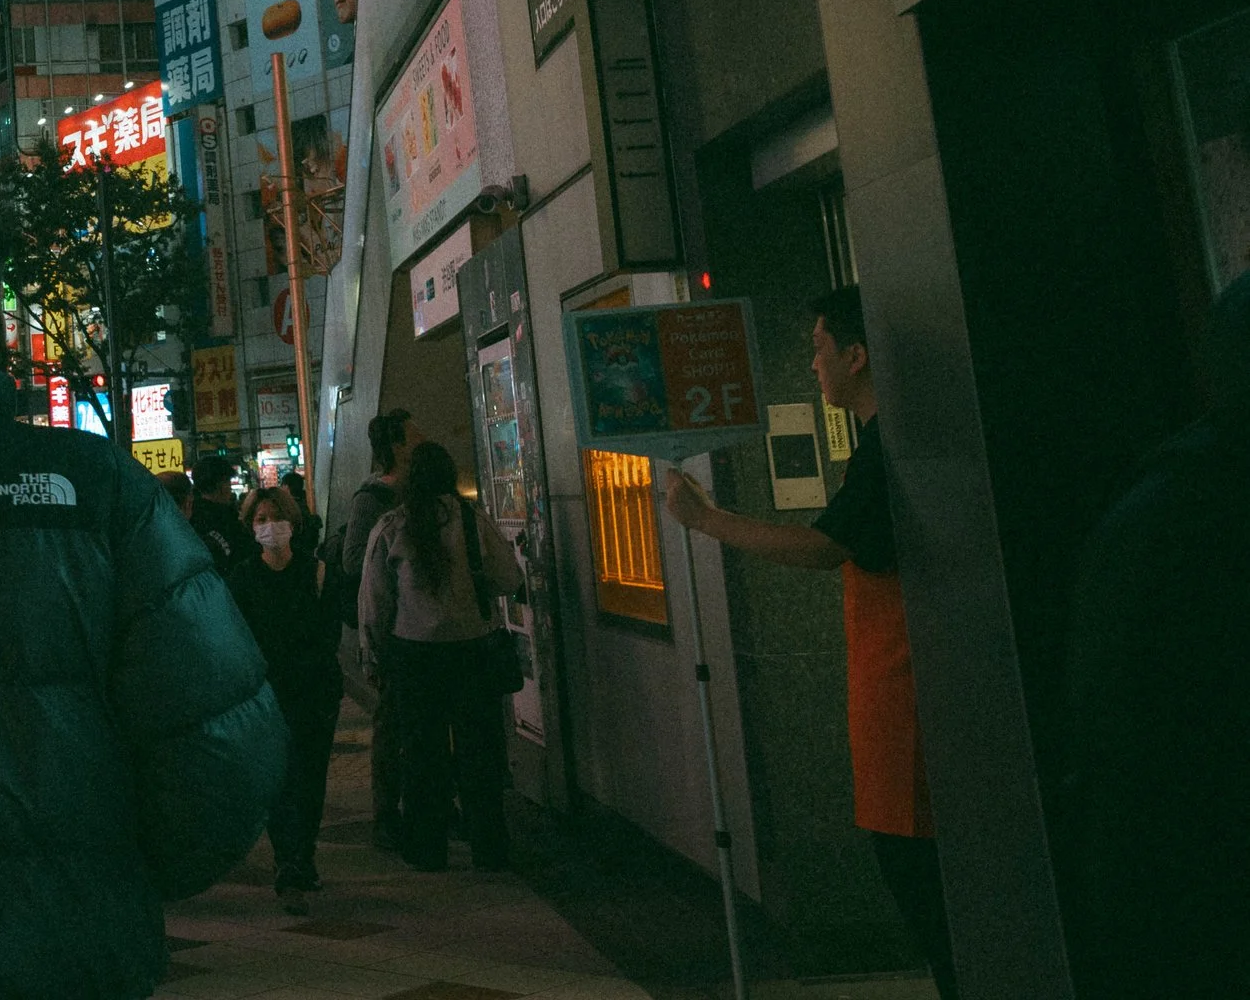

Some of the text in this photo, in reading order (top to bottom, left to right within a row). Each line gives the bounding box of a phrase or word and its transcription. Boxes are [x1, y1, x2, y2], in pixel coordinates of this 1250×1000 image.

[166, 48, 215, 107] 薬局
[62, 96, 166, 173] スギ薬局
[200, 117, 218, 150] OS
[833, 412, 846, 449] WARNING
[18, 472, 48, 483] THE
[13, 493, 52, 506] FACE
